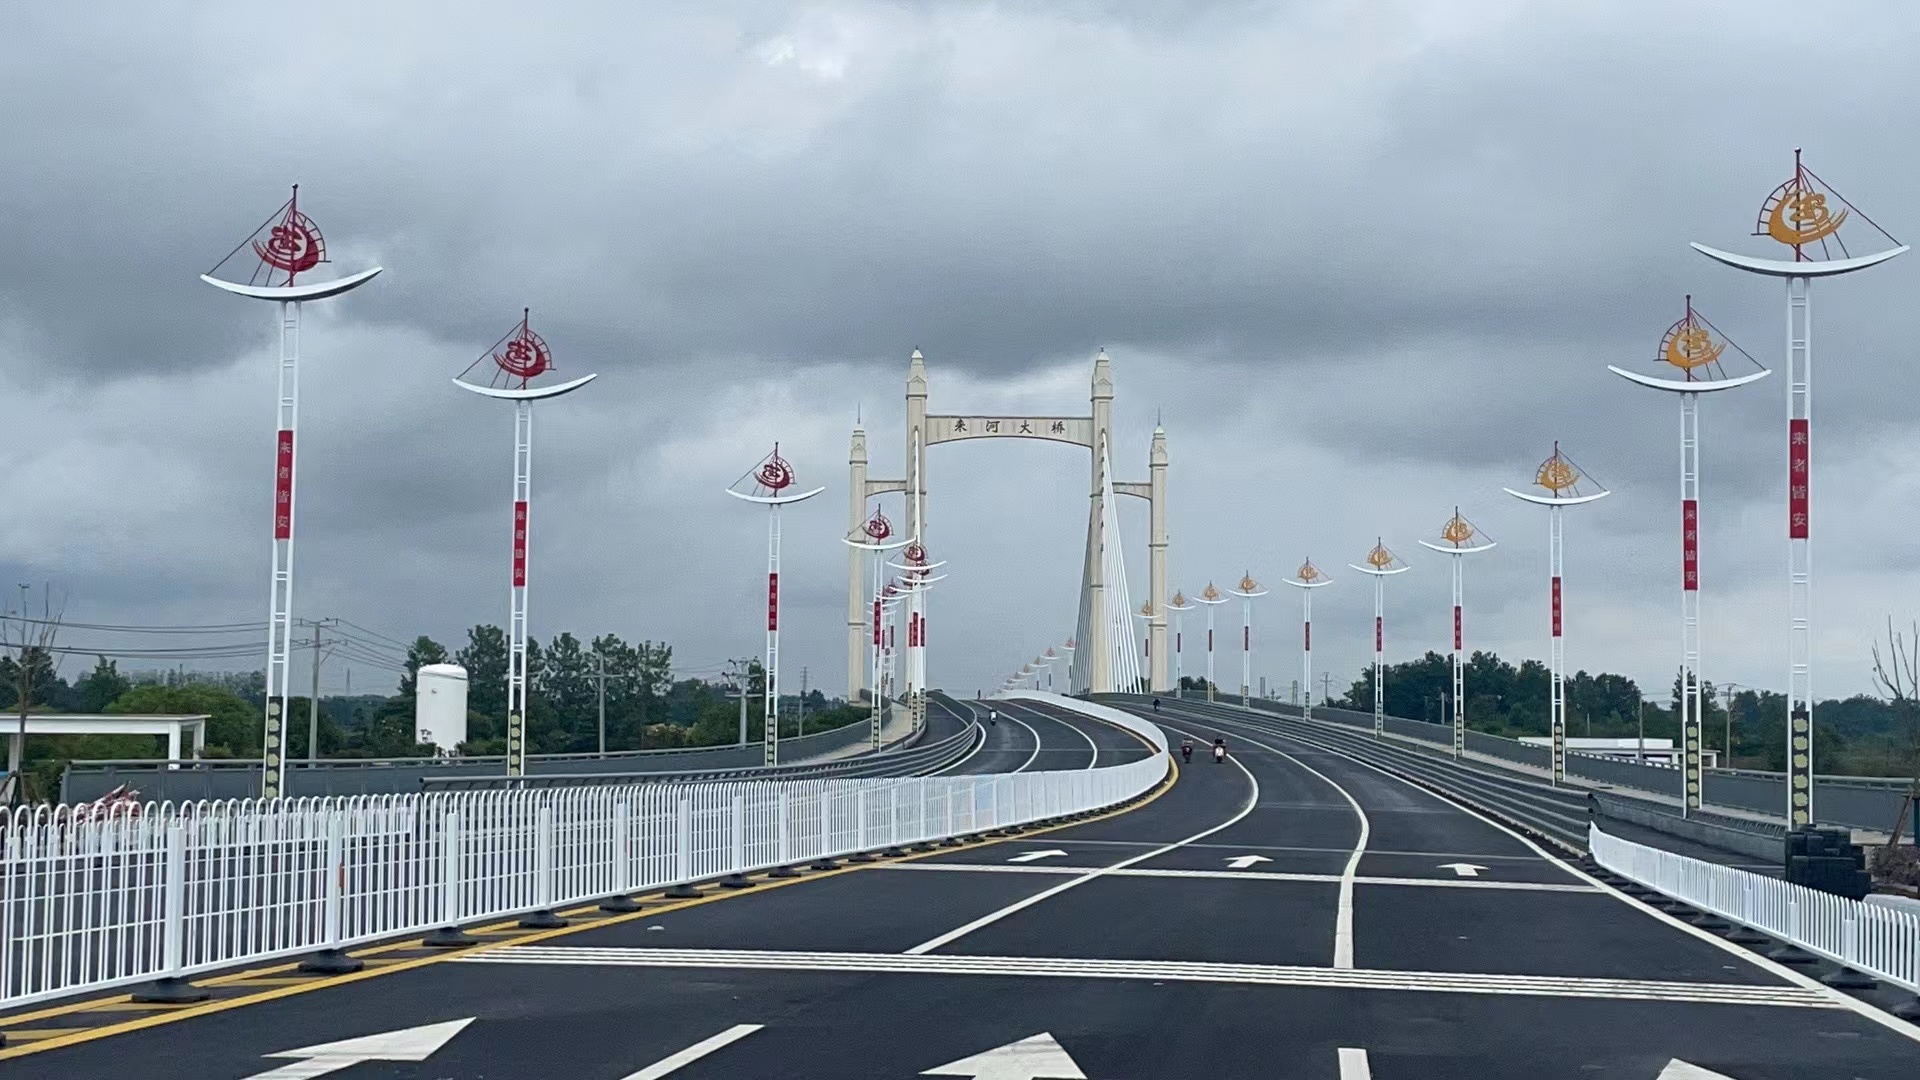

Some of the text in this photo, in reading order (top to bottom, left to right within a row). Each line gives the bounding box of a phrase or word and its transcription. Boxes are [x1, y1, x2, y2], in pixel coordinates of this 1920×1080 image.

[277, 442, 291, 529] 来者皆安
[1792, 432, 1806, 527] 来者皆安
